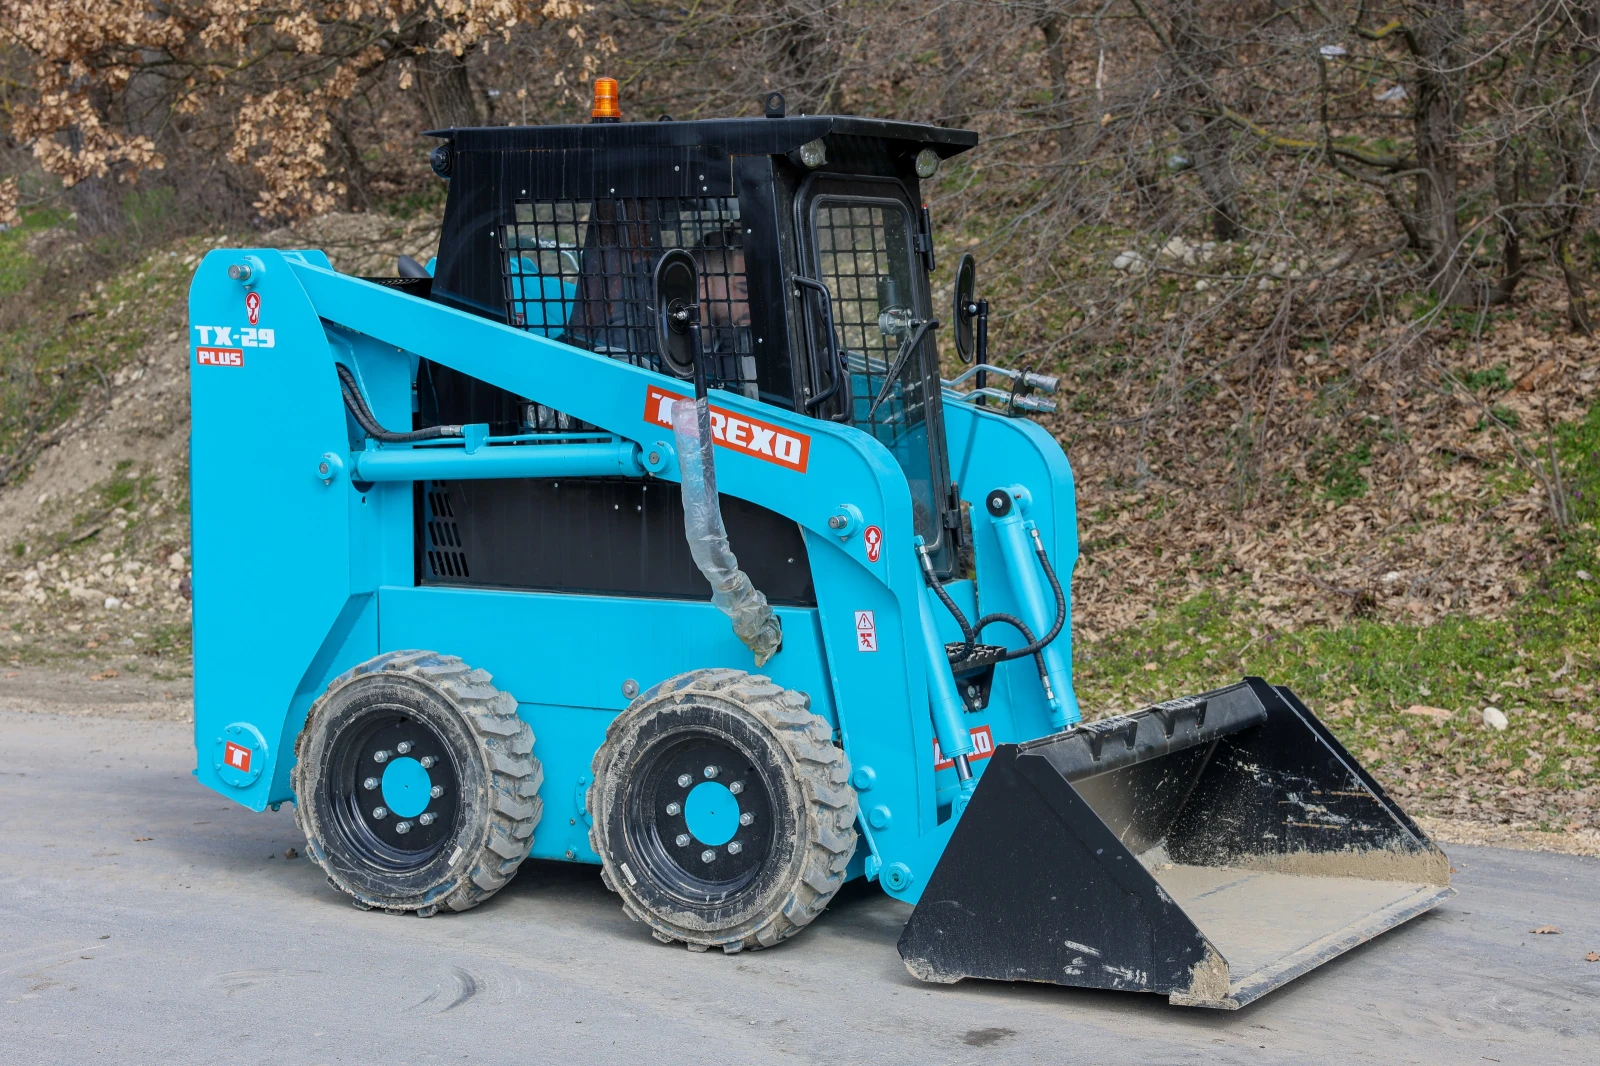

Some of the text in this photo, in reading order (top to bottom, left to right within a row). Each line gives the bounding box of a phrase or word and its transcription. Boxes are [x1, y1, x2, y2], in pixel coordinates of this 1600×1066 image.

[194, 325, 275, 348] TX-29
[199, 350, 241, 366] PLUS
[651, 392, 802, 465] TREXO
